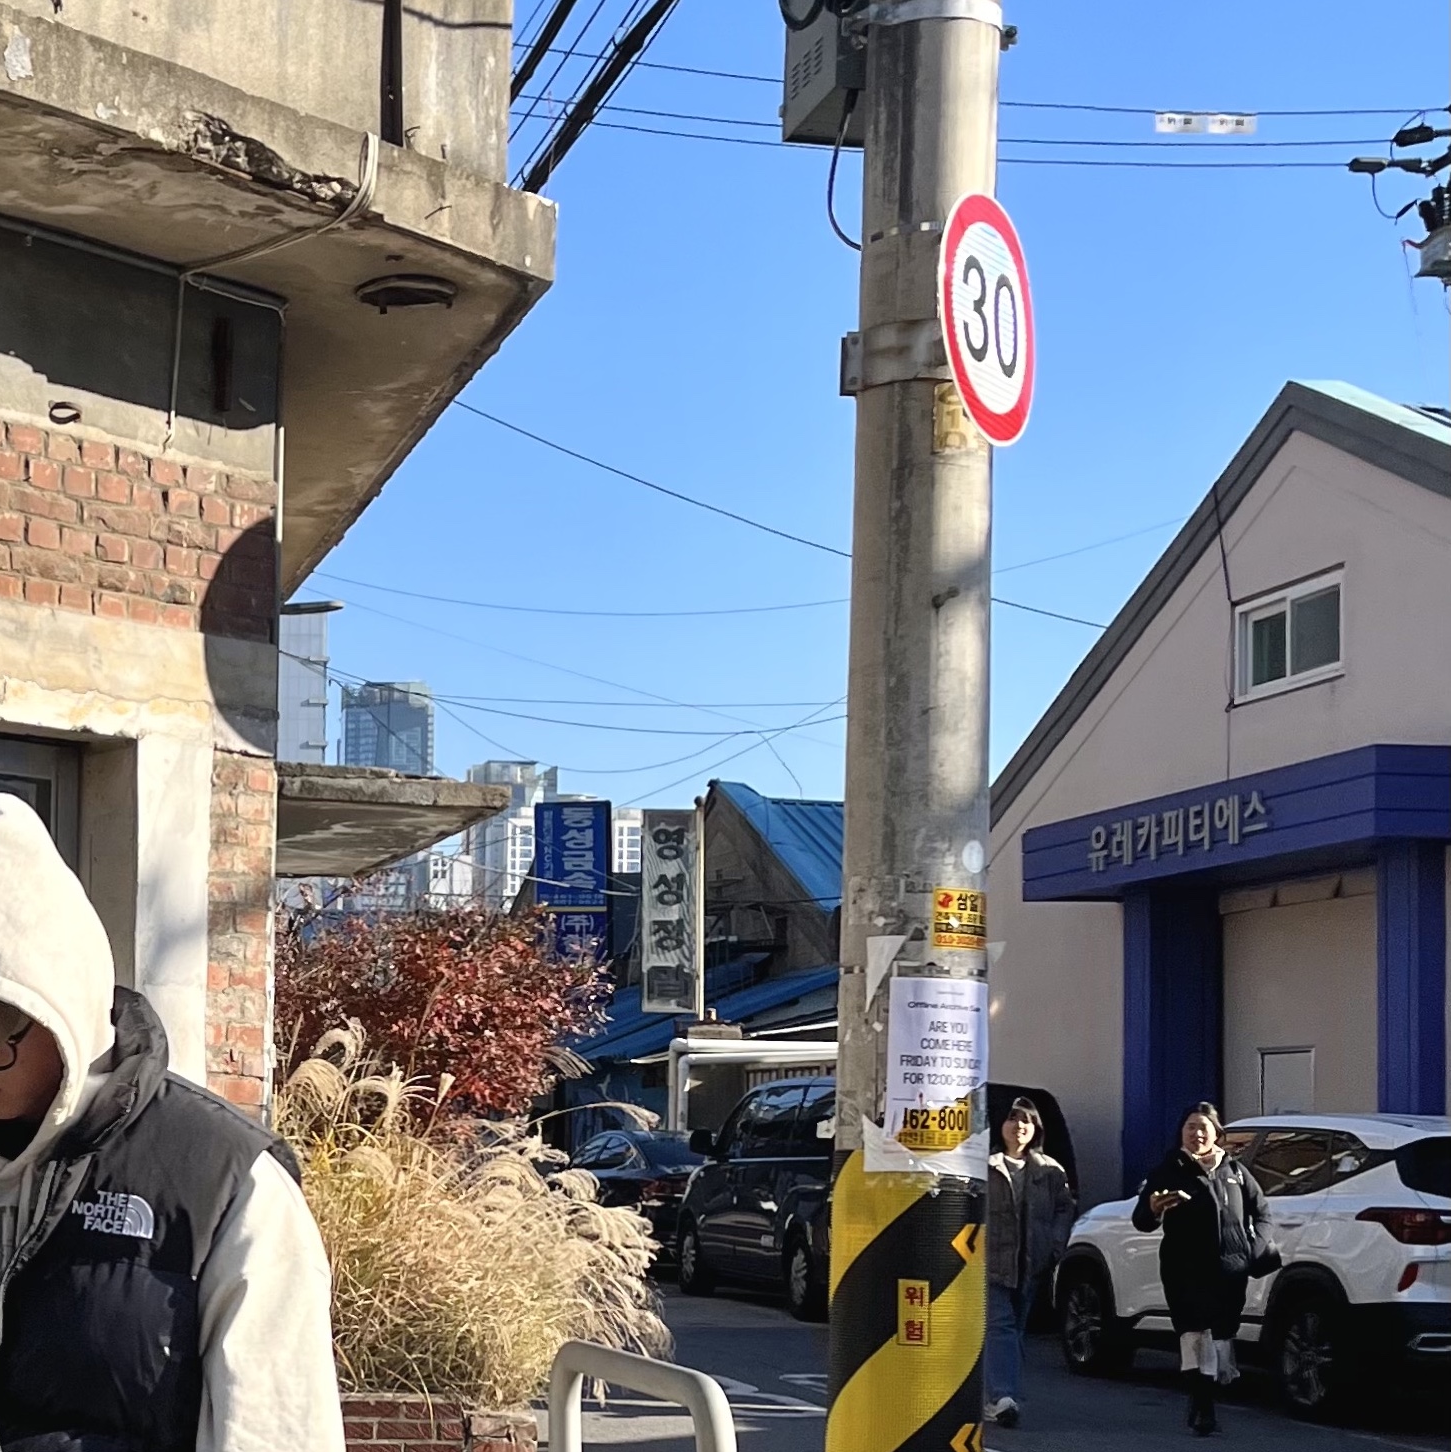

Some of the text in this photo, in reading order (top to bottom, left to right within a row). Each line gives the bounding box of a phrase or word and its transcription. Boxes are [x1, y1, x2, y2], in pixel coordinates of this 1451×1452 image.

[962, 255, 1018, 378] 30
[1088, 790, 1269, 873] 유레카피티에스
[928, 1021, 968, 1035] ARE YOU
[920, 1038, 950, 1051] COME
[899, 1055, 937, 1067] FRIDAY
[939, 1056, 953, 1069] TO
[903, 1072, 924, 1085] FOR
[97, 1189, 129, 1207] THE
[71, 1200, 127, 1221] NORTH
[83, 1216, 124, 1235] FACE
[905, 1286, 925, 1341] 위험
